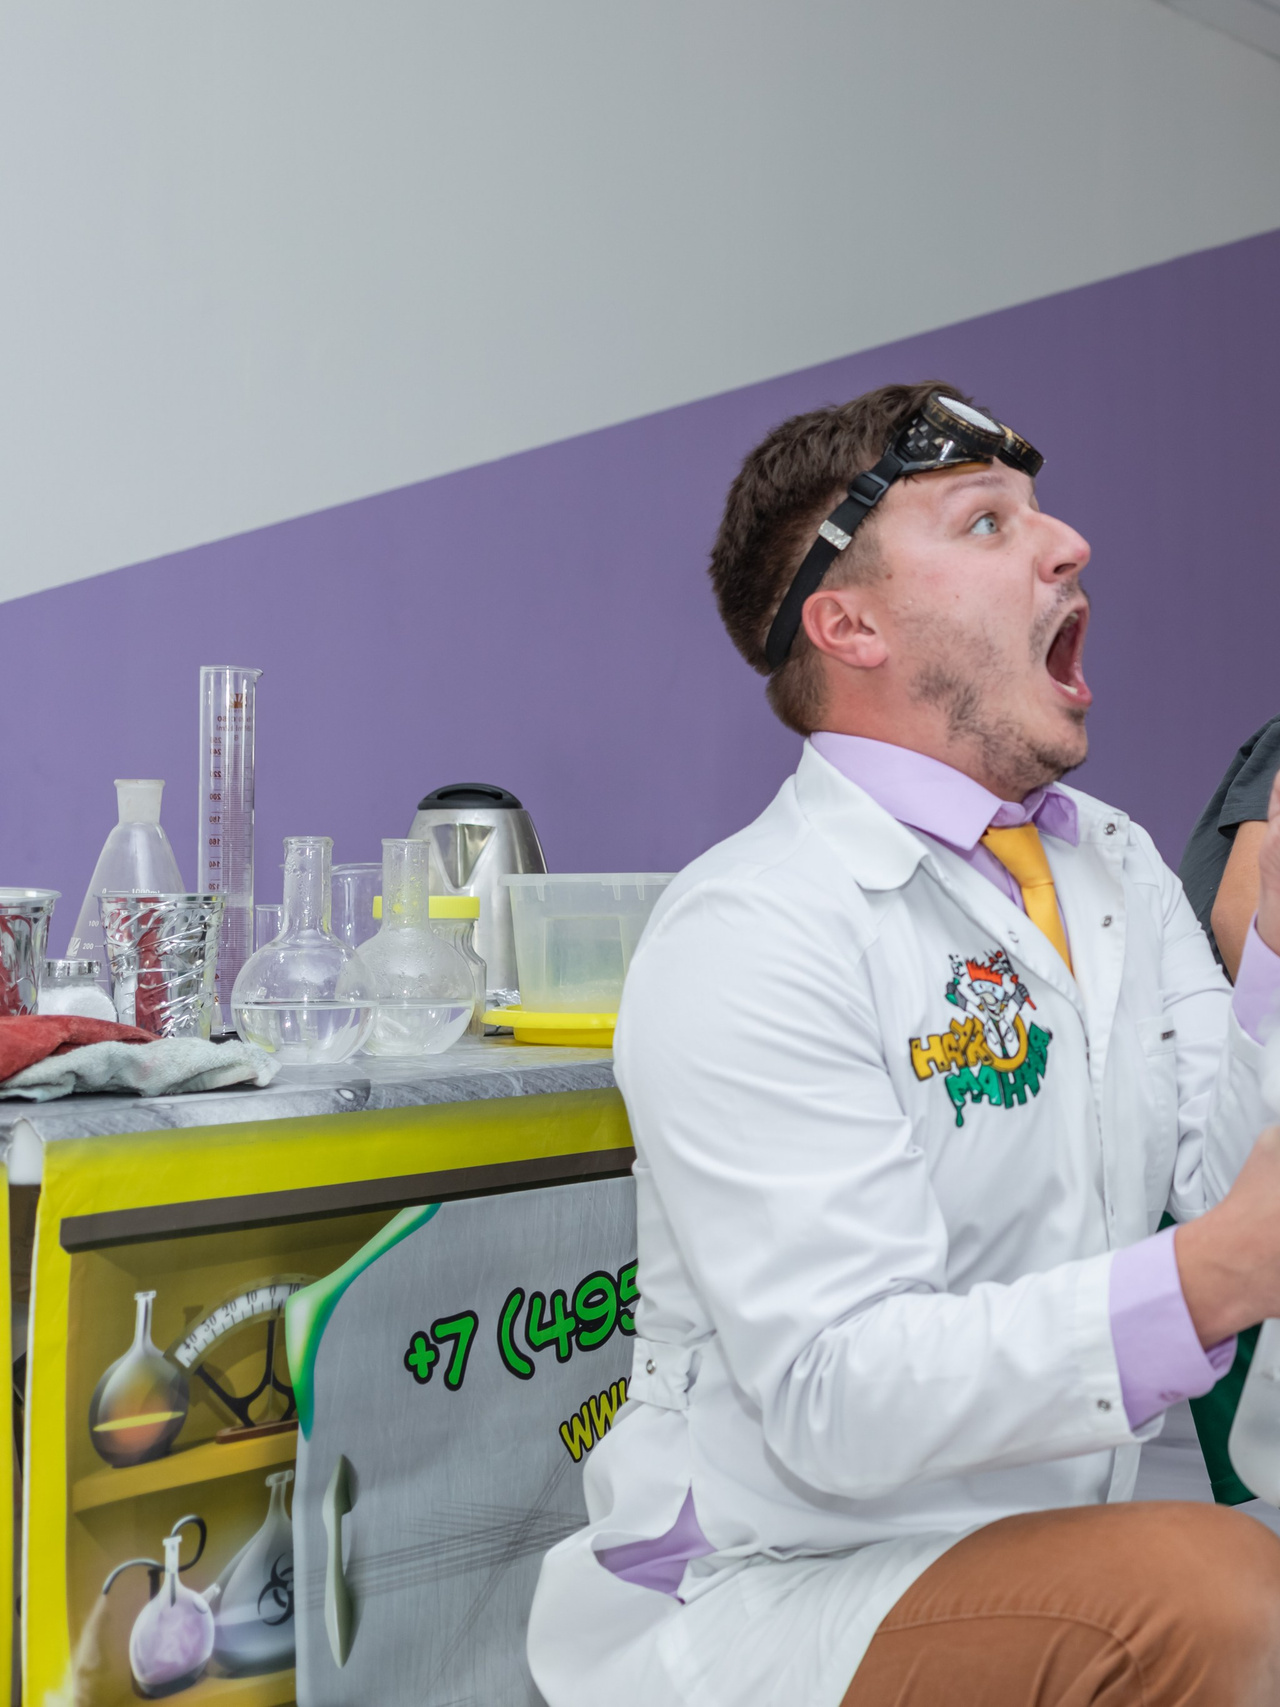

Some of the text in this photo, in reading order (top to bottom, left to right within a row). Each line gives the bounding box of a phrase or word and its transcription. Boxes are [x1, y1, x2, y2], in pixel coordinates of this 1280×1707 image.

[88, 920, 100, 928] 100
[82, 942, 94, 950] 200
[221, 1301, 238, 1318] 20
[245, 1289, 258, 1305] 10
[269, 1284, 277, 1298] 0
[404, 1309, 479, 1392] +7
